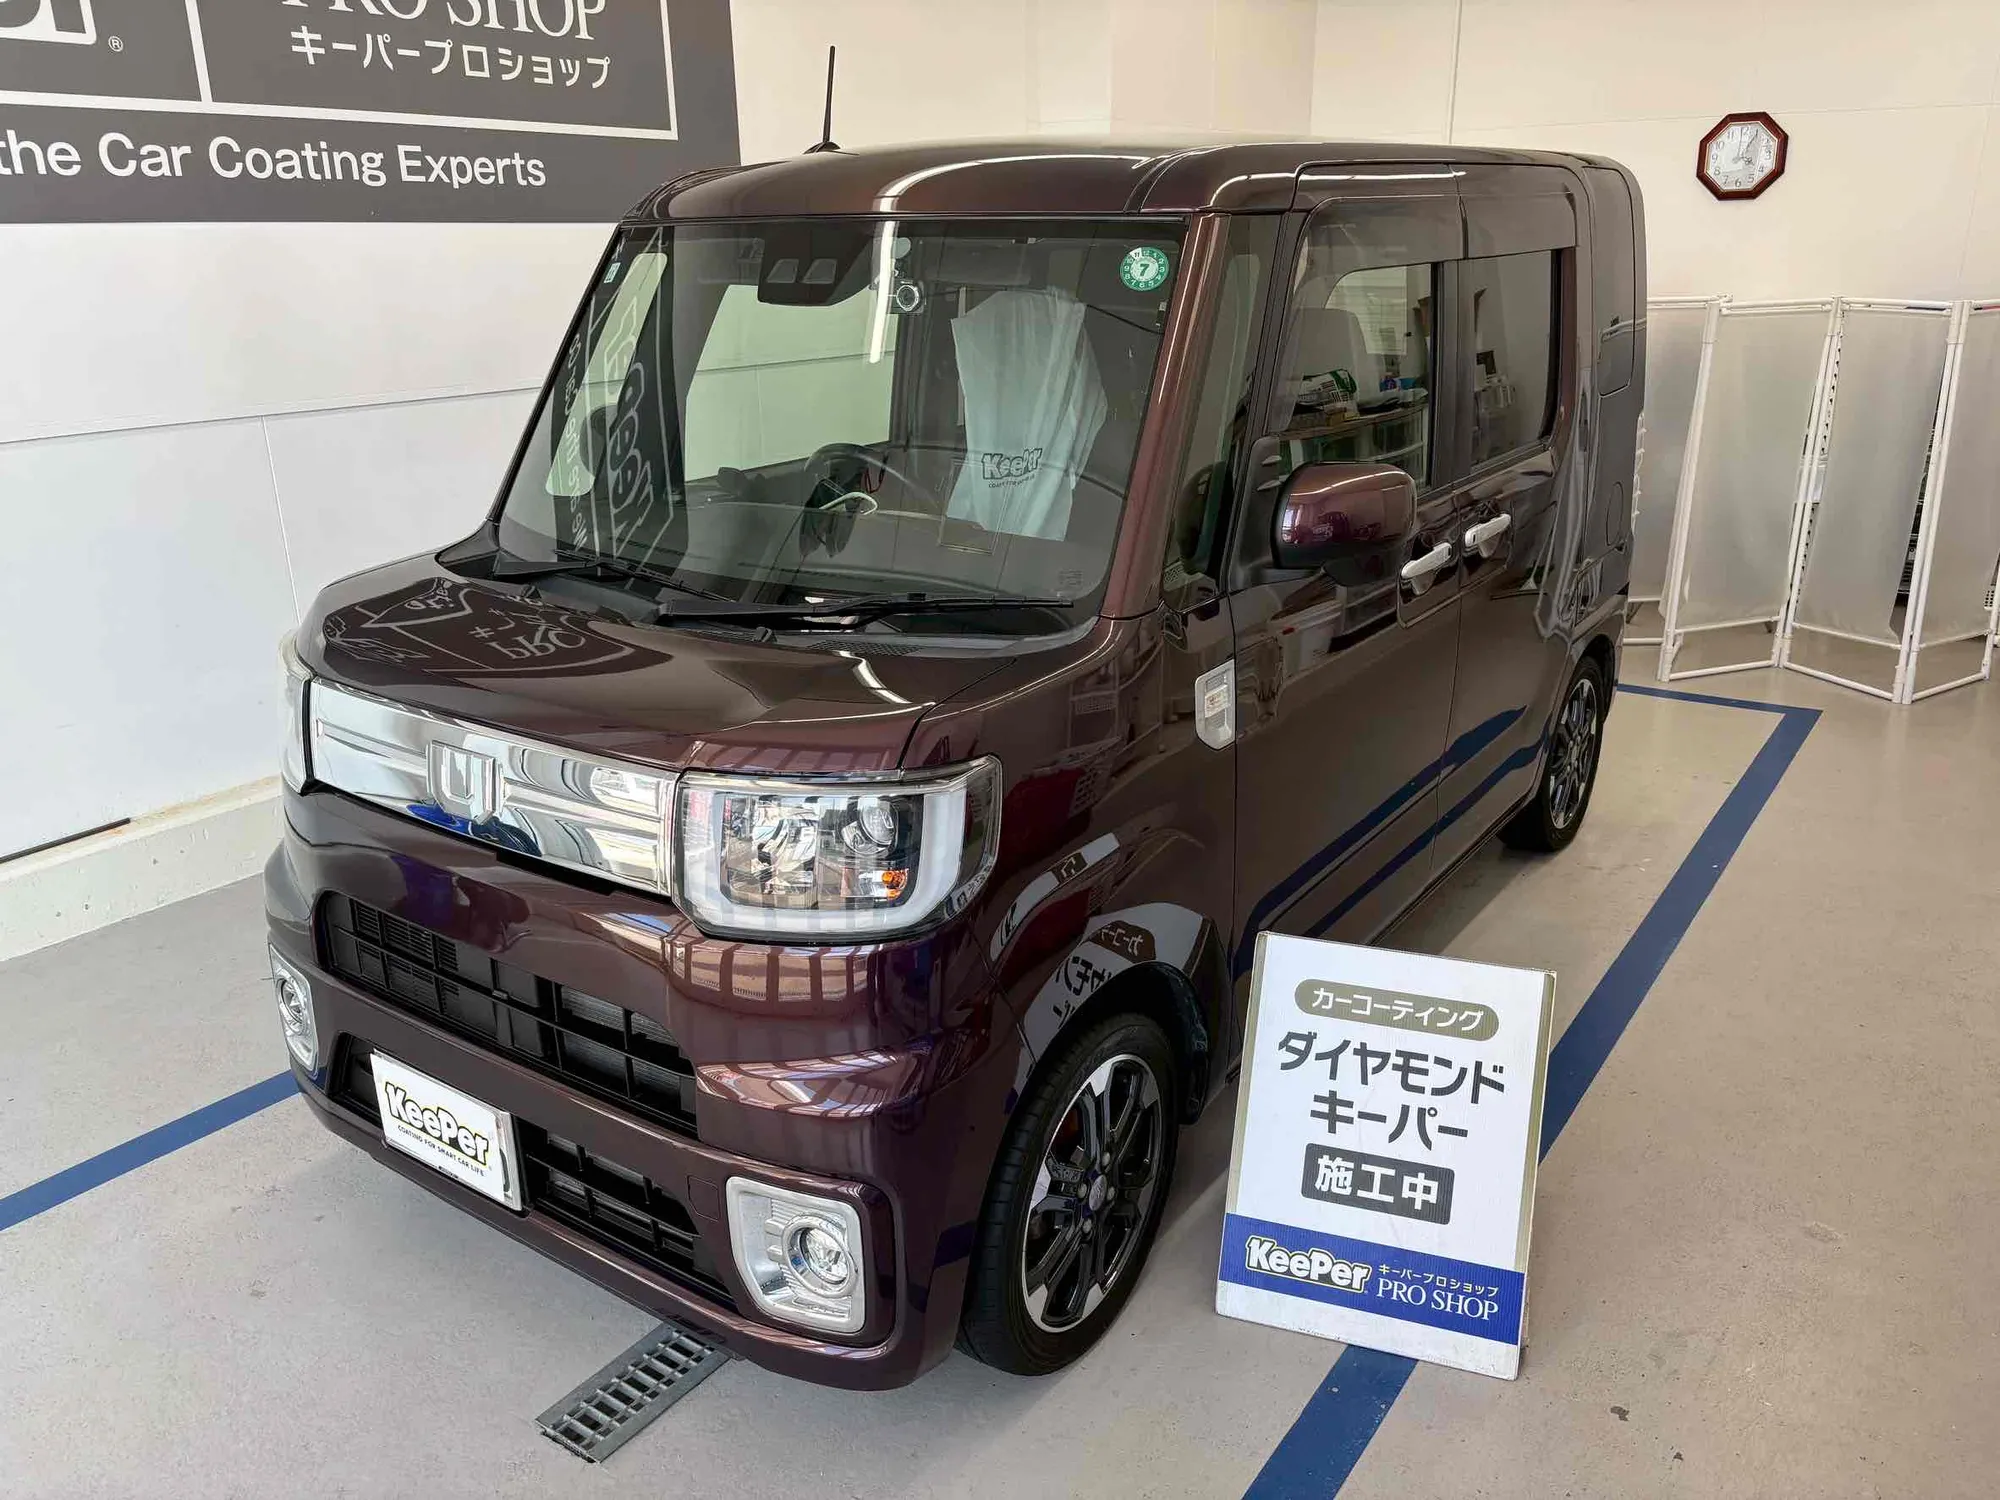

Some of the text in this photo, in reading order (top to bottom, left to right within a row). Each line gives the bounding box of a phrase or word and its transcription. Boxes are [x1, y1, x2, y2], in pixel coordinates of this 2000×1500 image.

[291, 26, 611, 89] キーパープロショップ
[98, 132, 192, 178] Car
[208, 136, 386, 187] Coating
[397, 144, 547, 188] Experts
[1140, 263, 1149, 276] 7
[1311, 987, 1484, 1032] カーコーティング
[1278, 1031, 1504, 1104] ダイヤモンド
[385, 1082, 489, 1165] KeePer
[1310, 1089, 1469, 1151] キーパー
[1314, 1154, 1439, 1210] 施工中
[1246, 1235, 1371, 1293] KeePer
[1376, 1277, 1499, 1320] PRO SHOP
